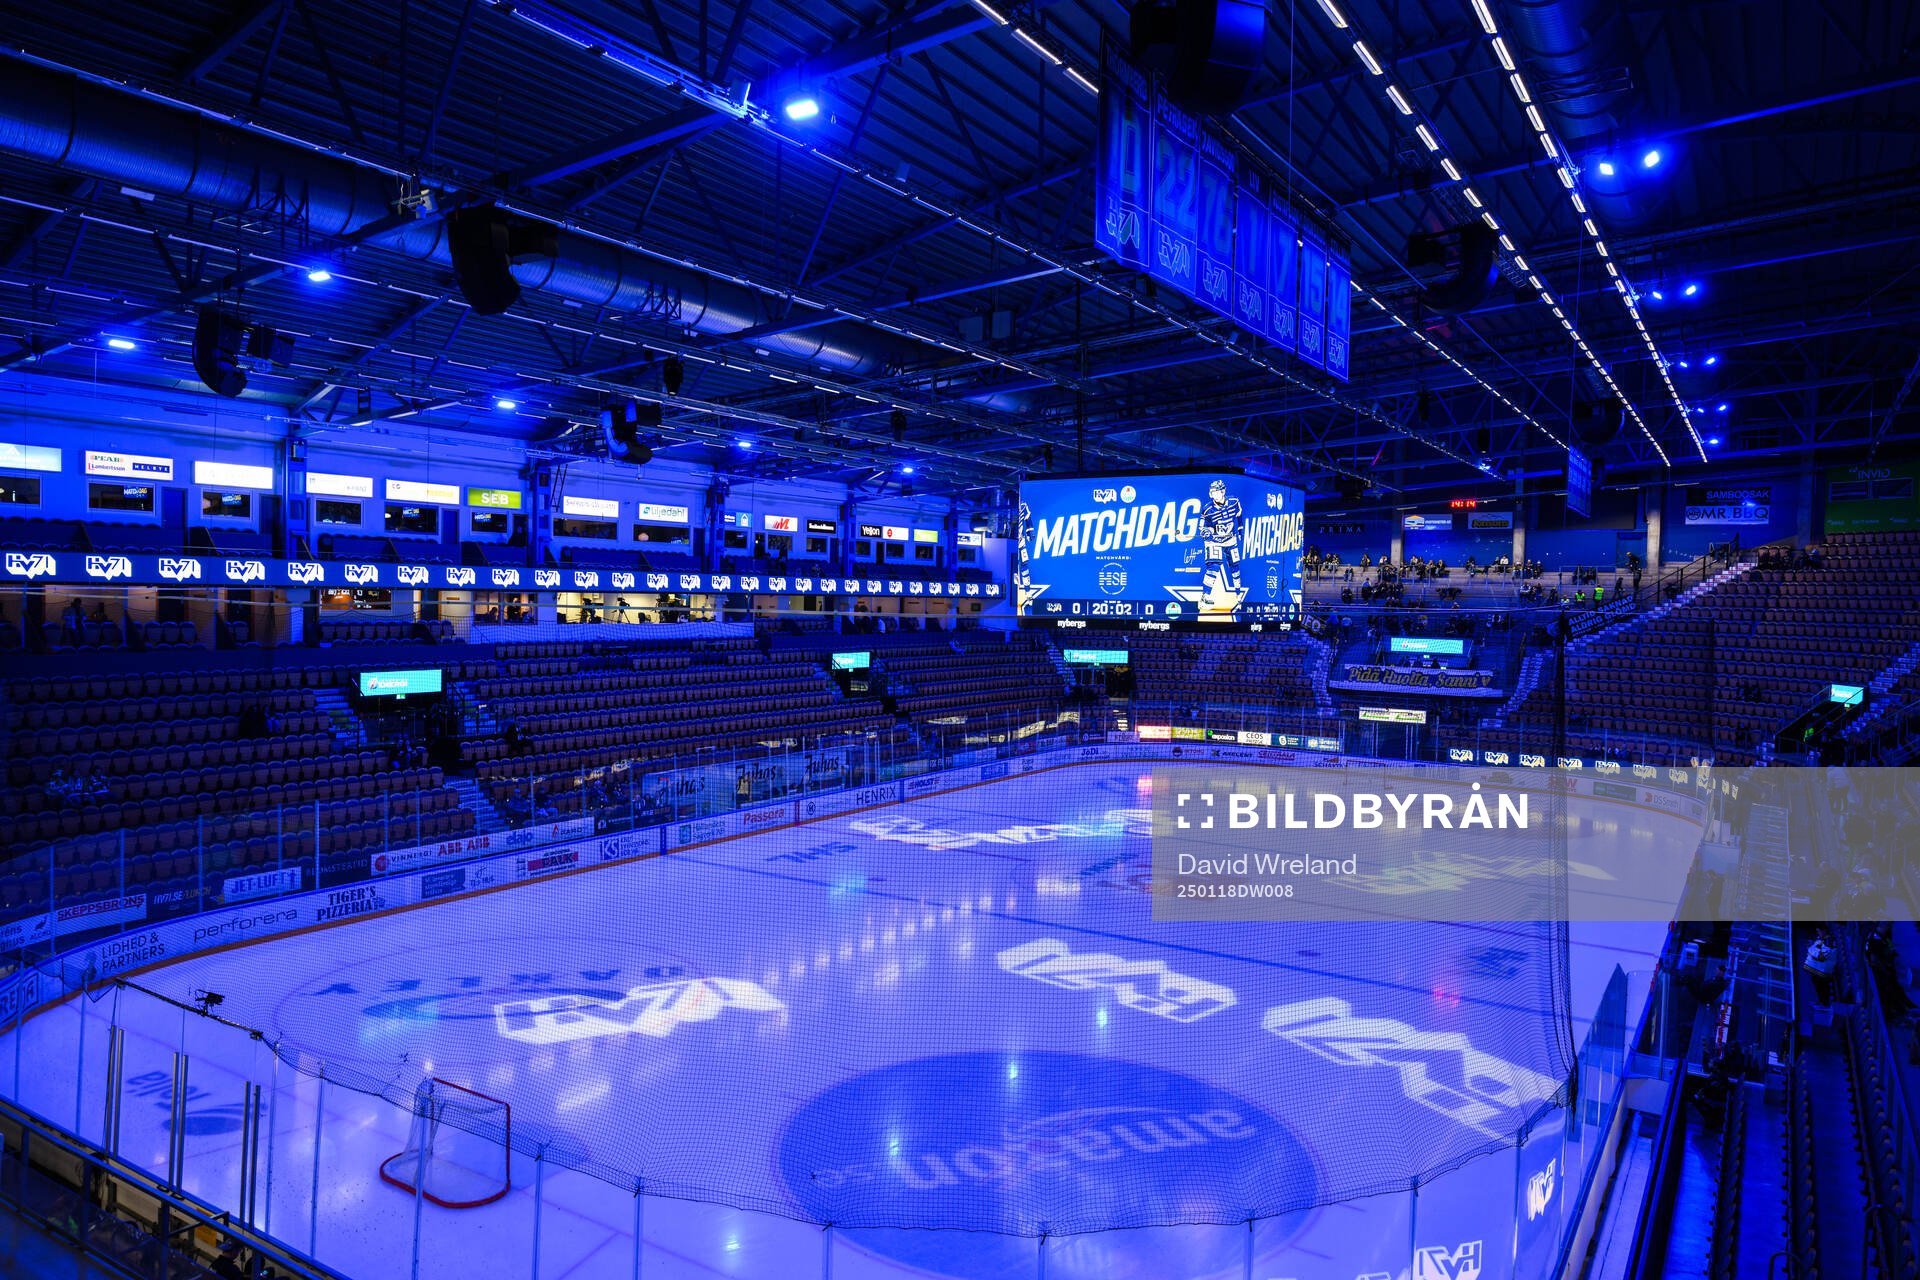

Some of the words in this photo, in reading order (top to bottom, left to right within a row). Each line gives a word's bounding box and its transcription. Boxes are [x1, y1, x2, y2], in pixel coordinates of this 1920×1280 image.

[1156, 135, 1198, 229] 22
[481, 492, 509, 505] SEB
[1093, 489, 1117, 504] HV71
[650, 506, 685, 518] Liljedahl
[1033, 498, 1202, 559] MATCHDAG
[1242, 511, 1303, 560] MATCHDAG
[6, 553, 56, 579] HV71
[86, 556, 132, 580] HV71
[159, 558, 201, 582] HV71
[226, 560, 265, 583] HV71
[288, 563, 324, 584] HV71
[345, 564, 378, 585] HV71
[398, 566, 429, 586] HV71
[447, 568, 475, 587] HV71
[492, 569, 519, 587] HV71
[535, 570, 560, 588] HV71
[575, 571, 598, 589] HV71
[612, 573, 634, 589] HV71
[647, 574, 668, 590] HV71
[680, 575, 700, 591] HV71
[712, 576, 730, 591] HV71
[741, 577, 759, 591] HV71
[769, 578, 786, 592] HV71
[796, 578, 812, 592] HV71
[1099, 572, 1128, 586] HSE
[1072, 603, 1081, 614] 0
[1092, 603, 1132, 615] 20:02
[1145, 604, 1154, 615] 0
[1057, 618, 1087, 629] nybergs
[1139, 620, 1170, 631] nybergs
[1349, 667, 1380, 682] Pidä
[1383, 670, 1432, 687] Huolta,
[1435, 672, 1480, 688] Sanni
[1246, 732, 1264, 740] CEOS
[856, 785, 897, 806] HENRIX
[743, 807, 785, 825] Passera
[438, 842, 463, 856] ABB
[467, 837, 490, 850] ABB
[506, 830, 533, 846] elajo
[328, 886, 376, 906] TIGER'S
[317, 899, 373, 921] PIZZERIA
[194, 909, 298, 943] perforera
[102, 935, 147, 960] LIDHED
[150, 932, 160, 944] &
[102, 944, 165, 973] PARTNERS
